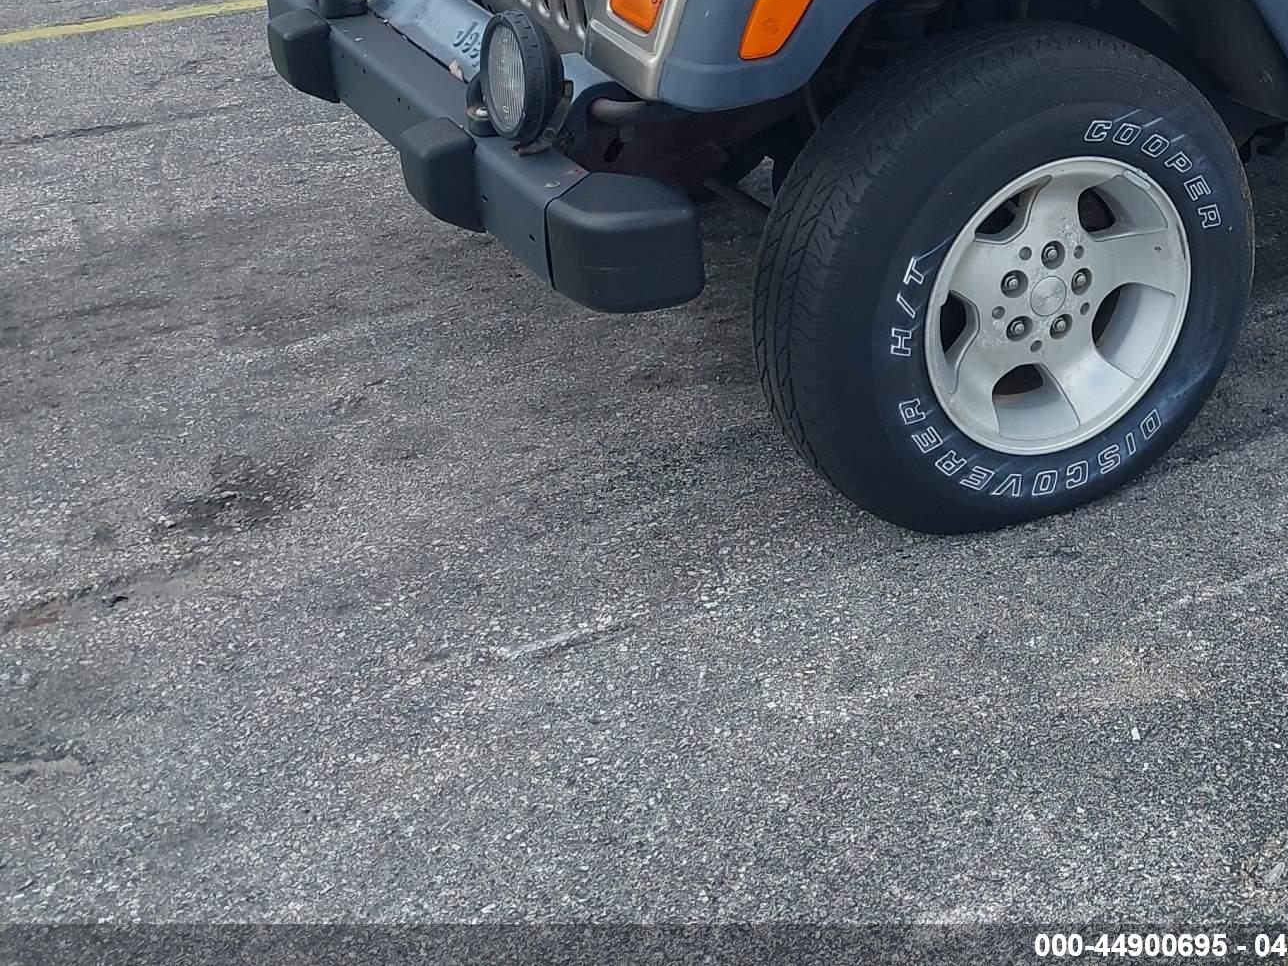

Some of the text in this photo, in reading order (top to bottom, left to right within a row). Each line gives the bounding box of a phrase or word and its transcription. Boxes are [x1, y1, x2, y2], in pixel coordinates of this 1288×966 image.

[1084, 120, 1222, 229] COOPER
[890, 257, 1162, 496] DISCOVERER H/T
